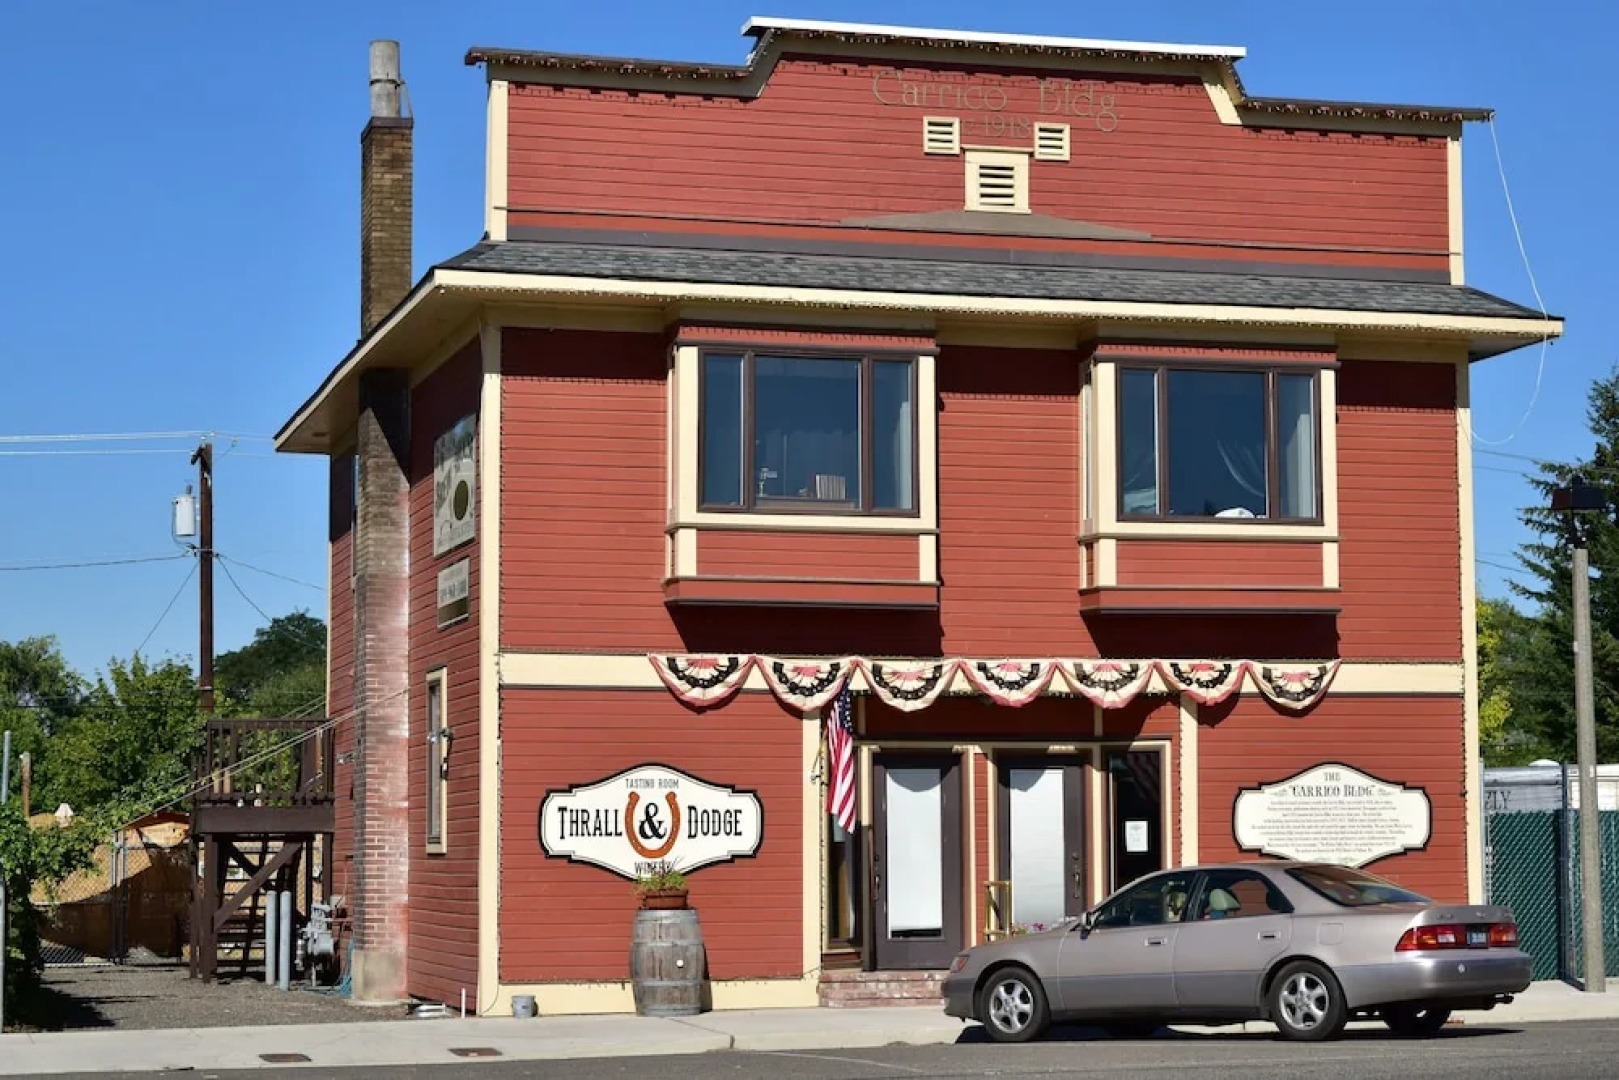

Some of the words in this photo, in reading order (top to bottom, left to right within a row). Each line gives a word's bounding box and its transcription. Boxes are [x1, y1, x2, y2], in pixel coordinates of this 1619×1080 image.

[873, 70, 1008, 111] Carrico
[1037, 79, 1118, 132] Bldg
[984, 115, 1031, 138] 1918
[625, 778, 655, 789] TASTING
[658, 778, 680, 789] ROOM
[1323, 772, 1341, 782] THE
[557, 806, 623, 840] THRALL
[638, 802, 667, 840] &
[687, 805, 743, 840] DODGE
